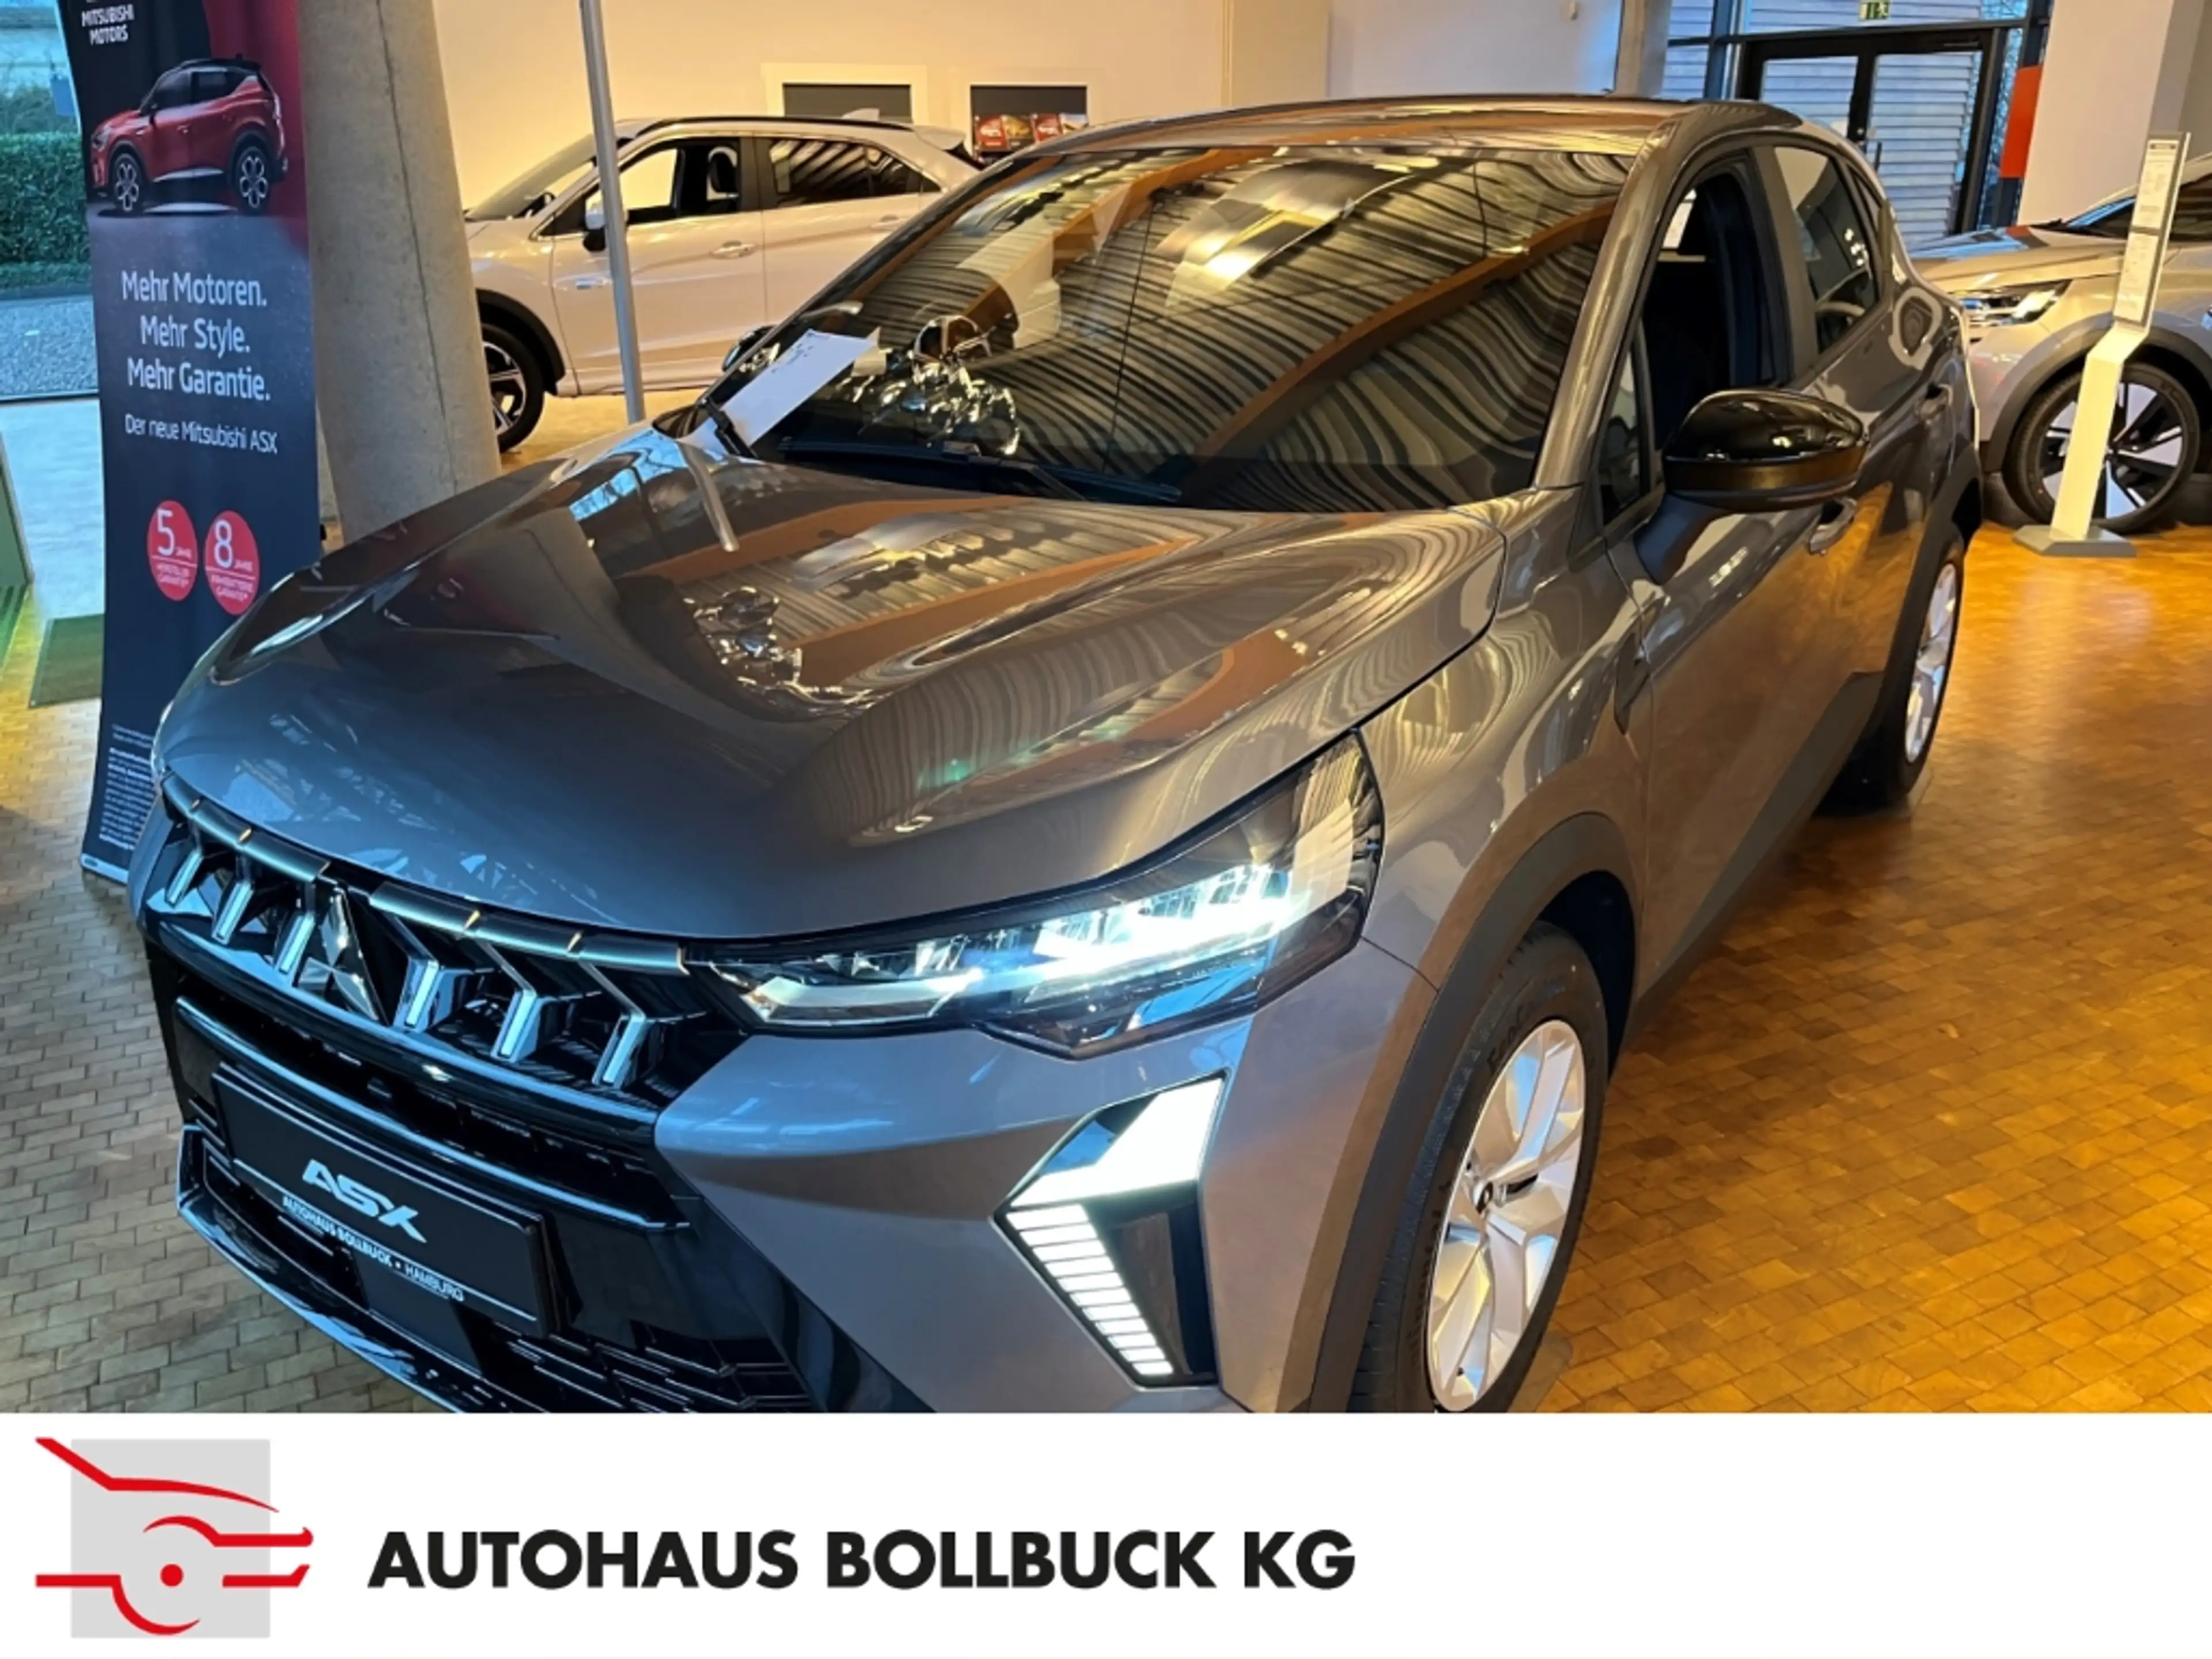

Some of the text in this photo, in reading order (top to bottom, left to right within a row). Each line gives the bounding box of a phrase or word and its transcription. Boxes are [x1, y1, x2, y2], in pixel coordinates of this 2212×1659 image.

[81, 3, 135, 26] MITSUBISHI
[89, 24, 128, 46] MOTORS
[121, 270, 267, 306] Mehr Motoren.
[140, 315, 250, 358] Mehr Style.
[127, 357, 271, 400] Mehr Garantie.
[124, 412, 278, 454] Der neue Mitsubishi ASX
[157, 507, 175, 556] 5
[214, 519, 233, 569] 8
[302, 1158, 427, 1243] ASX
[283, 1195, 465, 1301] AUTOHAUS BOLLBUCK HAMBURG
